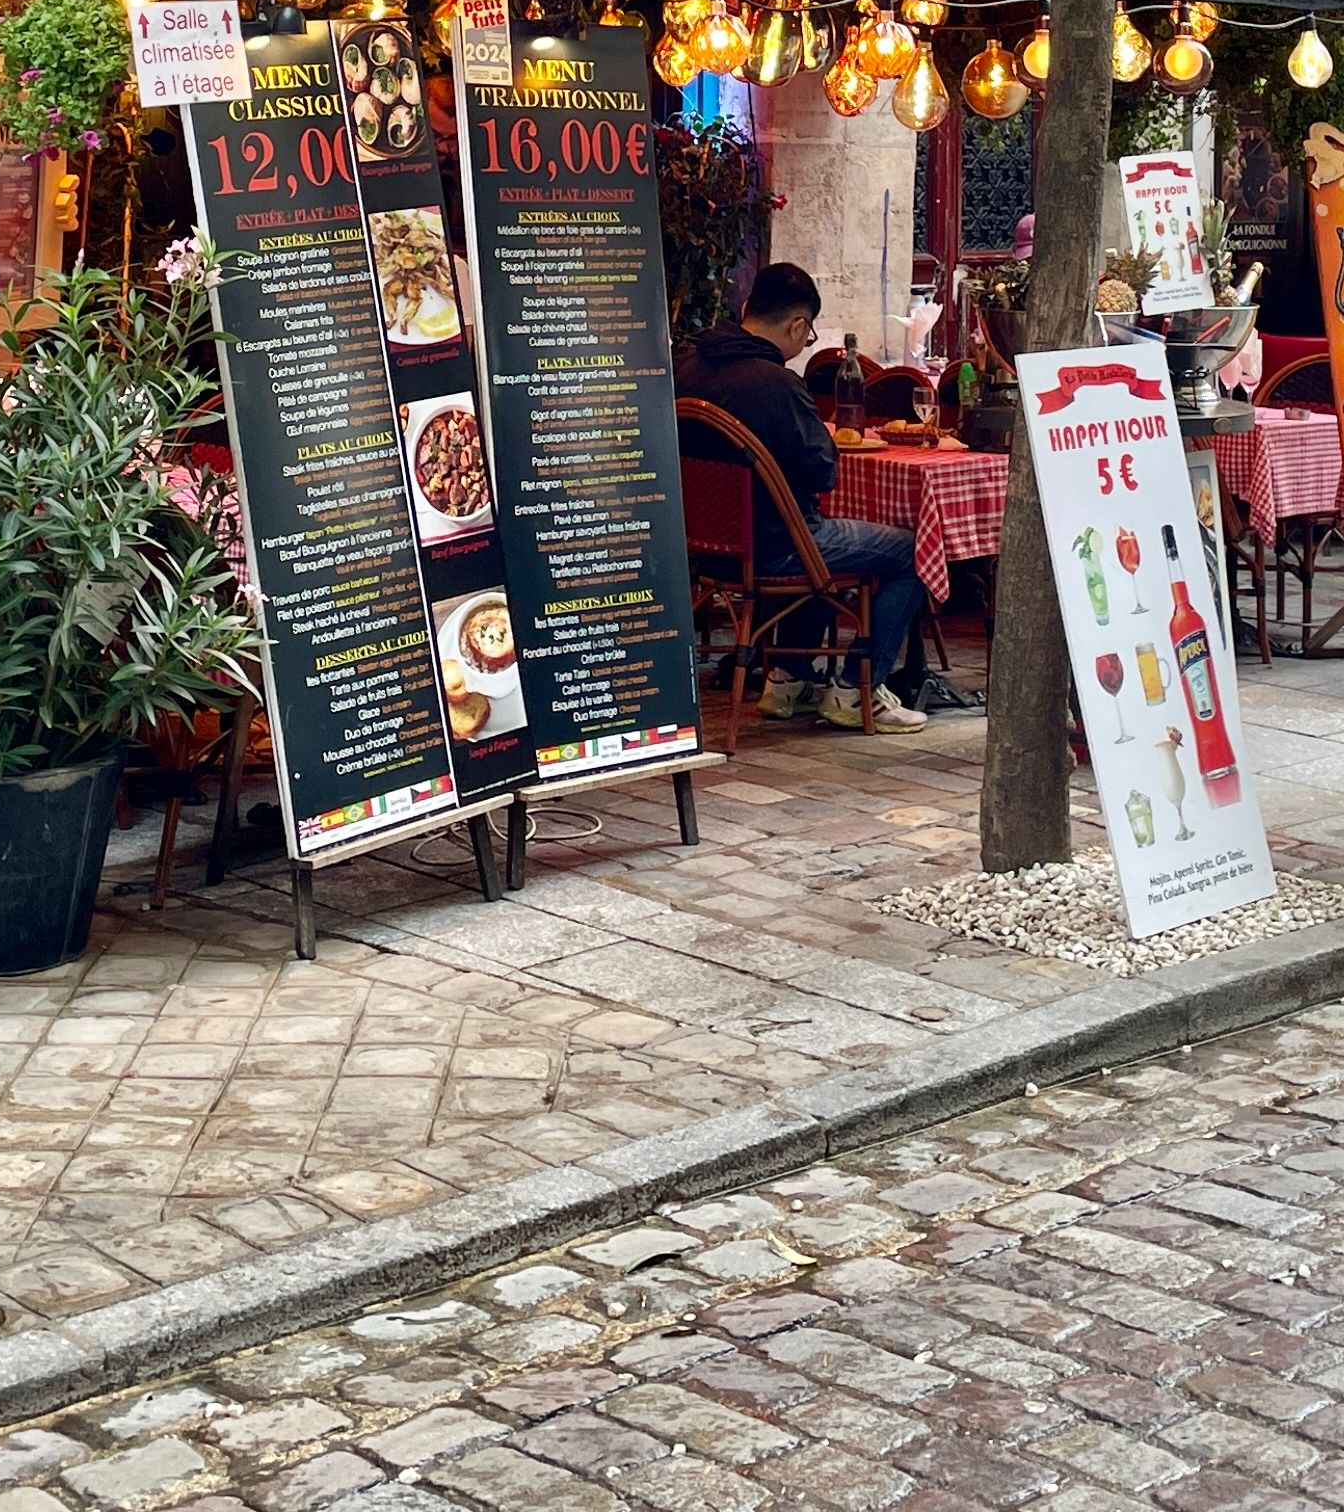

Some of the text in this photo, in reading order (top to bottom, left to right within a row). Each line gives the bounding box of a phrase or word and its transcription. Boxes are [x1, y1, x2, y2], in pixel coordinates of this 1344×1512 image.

[163, 8, 209, 31] Salle
[472, 10, 506, 29] futé
[142, 39, 235, 65] climatisée
[252, 63, 331, 90] MENU
[522, 57, 596, 83] MENU
[154, 73, 234, 97] à l'étage
[474, 85, 646, 112] TRADITIONNEL
[474, 115, 652, 183] 16,00€
[1135, 184, 1188, 199] HAPPY HOUR
[1154, 200, 1161, 214] 5
[1048, 415, 1169, 452] HAPPY HOUR
[1097, 453, 1139, 495] 5 €
